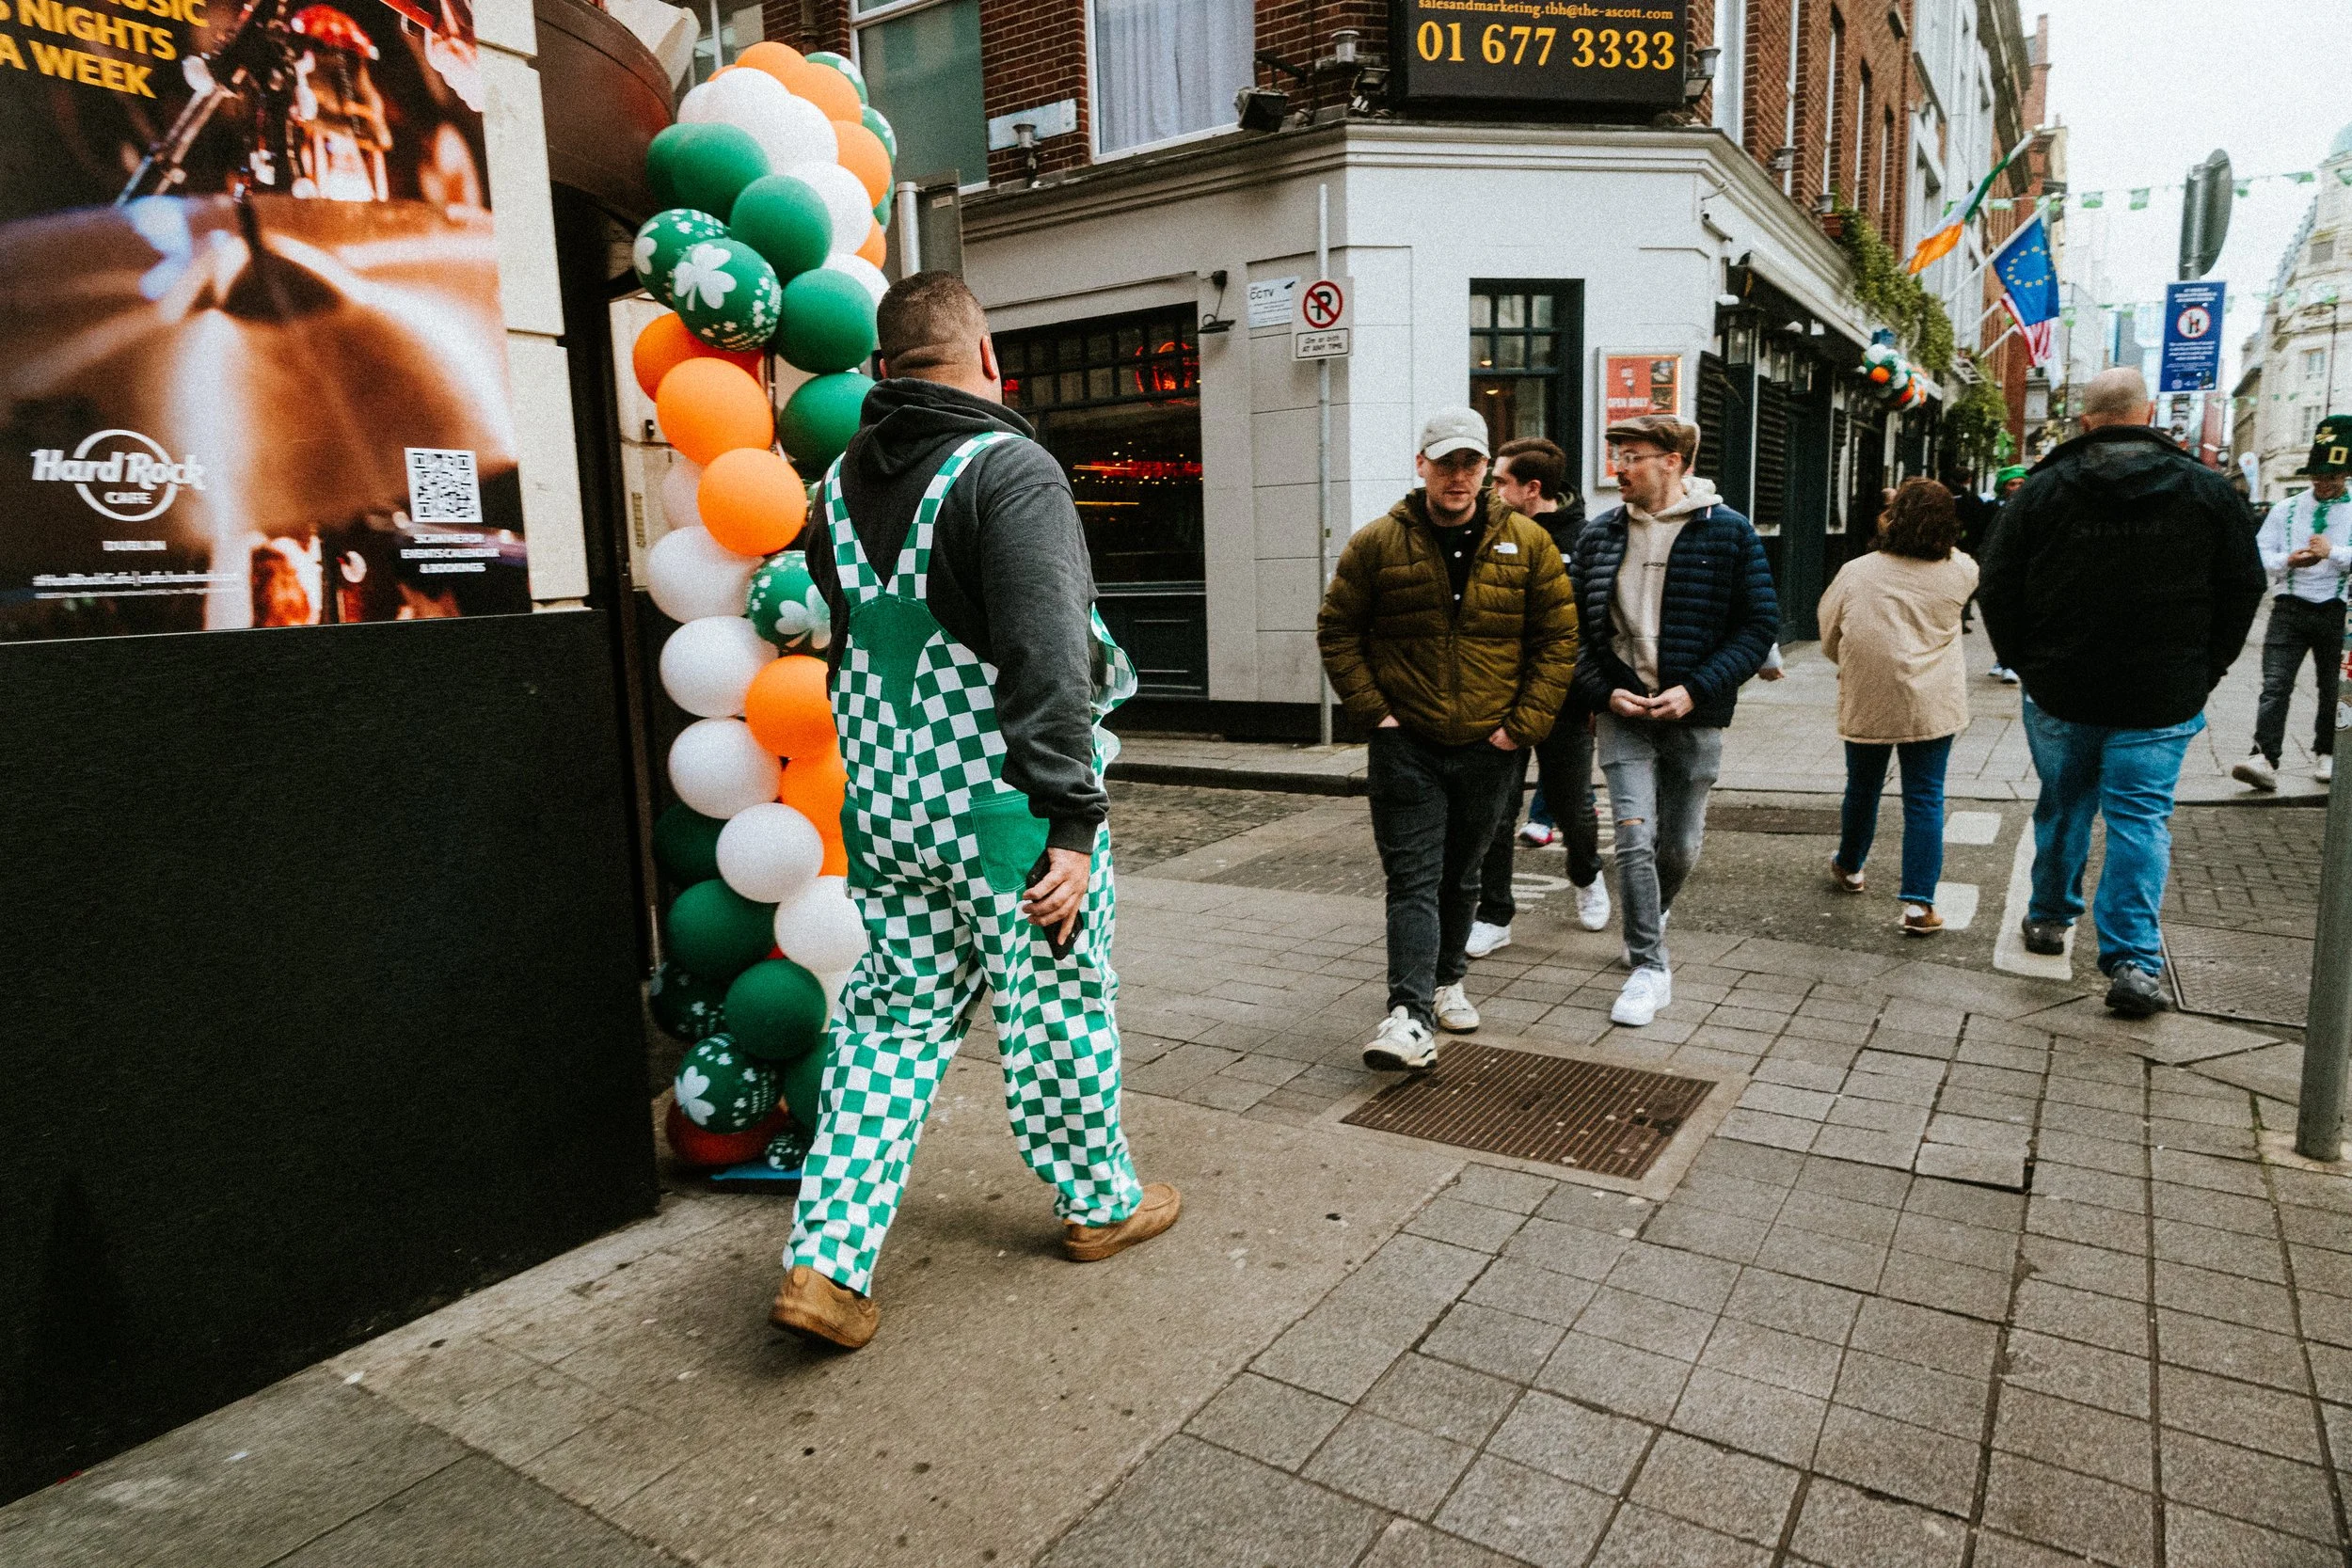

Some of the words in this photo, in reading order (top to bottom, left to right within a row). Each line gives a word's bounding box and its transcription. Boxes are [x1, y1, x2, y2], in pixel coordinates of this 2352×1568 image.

[18, 0, 177, 60] NIGHTS
[105, 0, 210, 27] SIC
[0, 34, 27, 71] A
[28, 40, 157, 99] WEEK
[1417, 21, 1465, 62] 01
[1482, 24, 1556, 66] 677
[1571, 28, 1675, 71] 3333
[1249, 289, 1274, 300] CCTV
[31, 449, 125, 483] Hard
[125, 452, 206, 490] Rock
